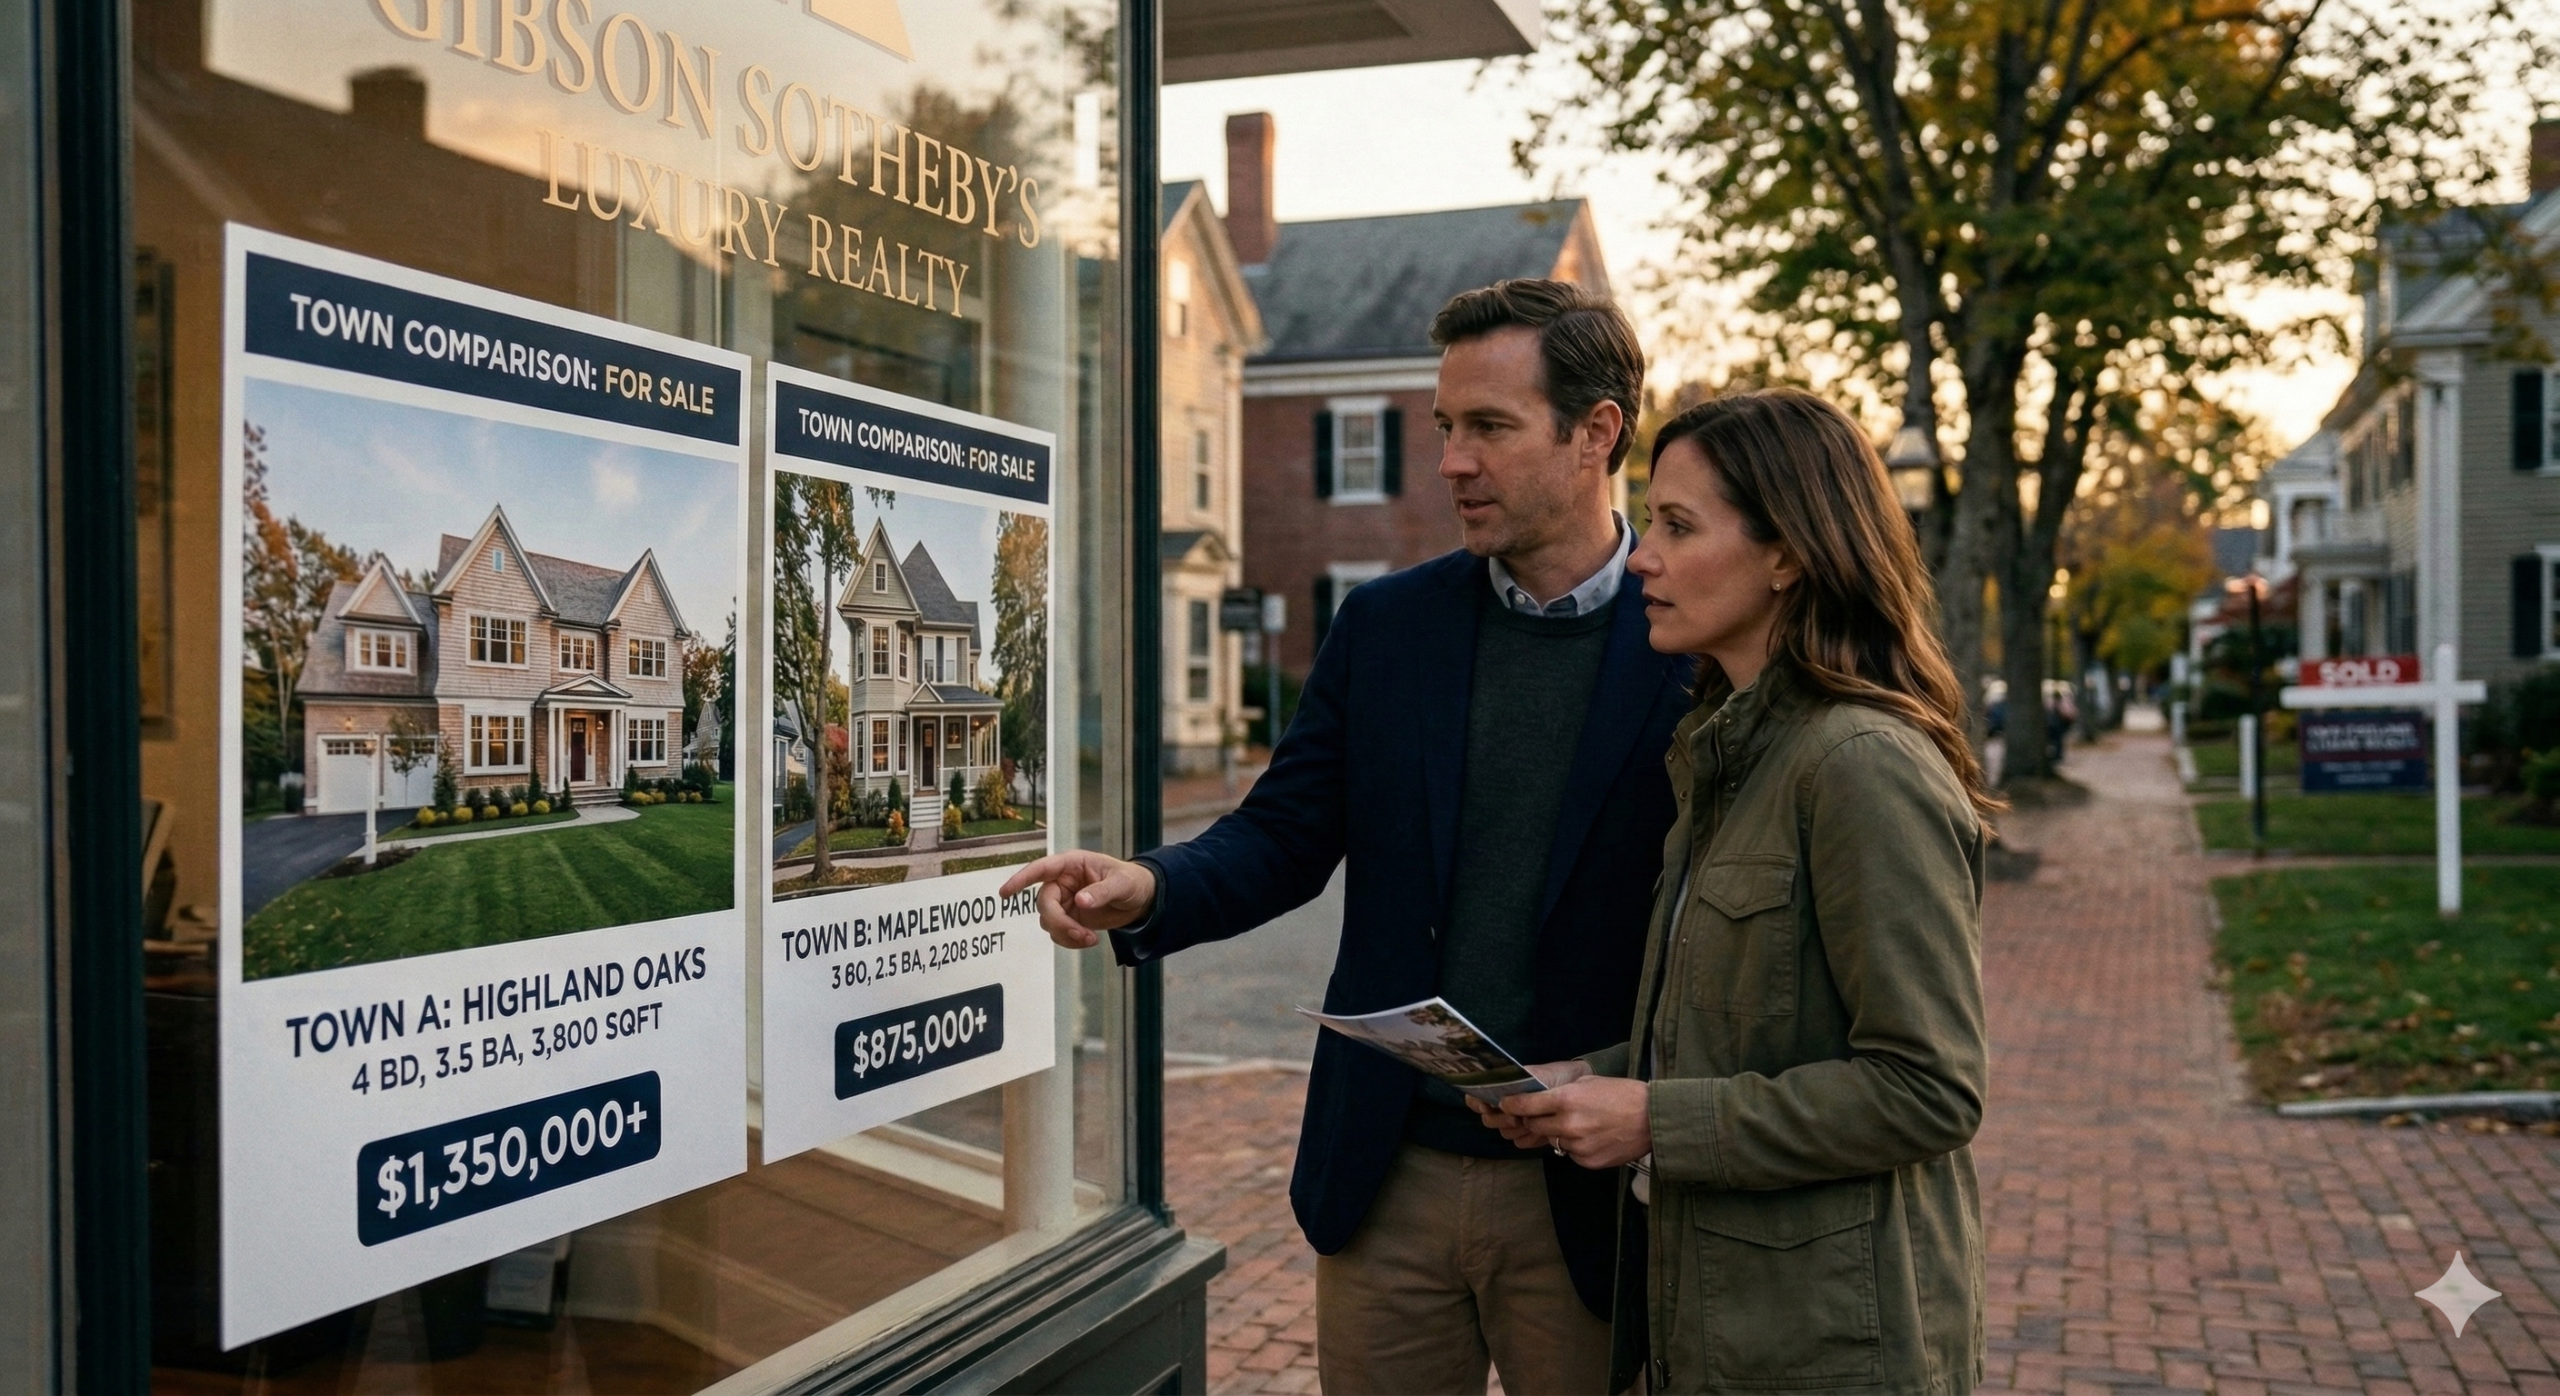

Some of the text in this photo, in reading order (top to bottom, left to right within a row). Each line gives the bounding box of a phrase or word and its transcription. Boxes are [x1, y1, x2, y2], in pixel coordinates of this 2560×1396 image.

[541, 128, 969, 318] LUXURY REALTY
[289, 292, 715, 416] TOWN COMPARISON: FOR SALE
[798, 407, 1036, 482] TOWN COMPARISON: FOR SALE
[2319, 659, 2401, 686] SOLD
[781, 920, 848, 962] TOWN
[853, 918, 872, 949] B:
[877, 895, 996, 943] MAPLEWOOD
[831, 964, 841, 990] 3
[875, 953, 898, 980] 2.5
[901, 949, 926, 975] BA,
[929, 938, 968, 972] 2,208
[971, 931, 1006, 958] SQFT
[286, 946, 707, 1058] TOWN A: HIGHLAND OAKS
[852, 1005, 988, 1079] $875,000+
[351, 1001, 664, 1096] 4 BD, 3.5 BA, 3,800 SQFT
[376, 1099, 648, 1220] $1,350,000+
